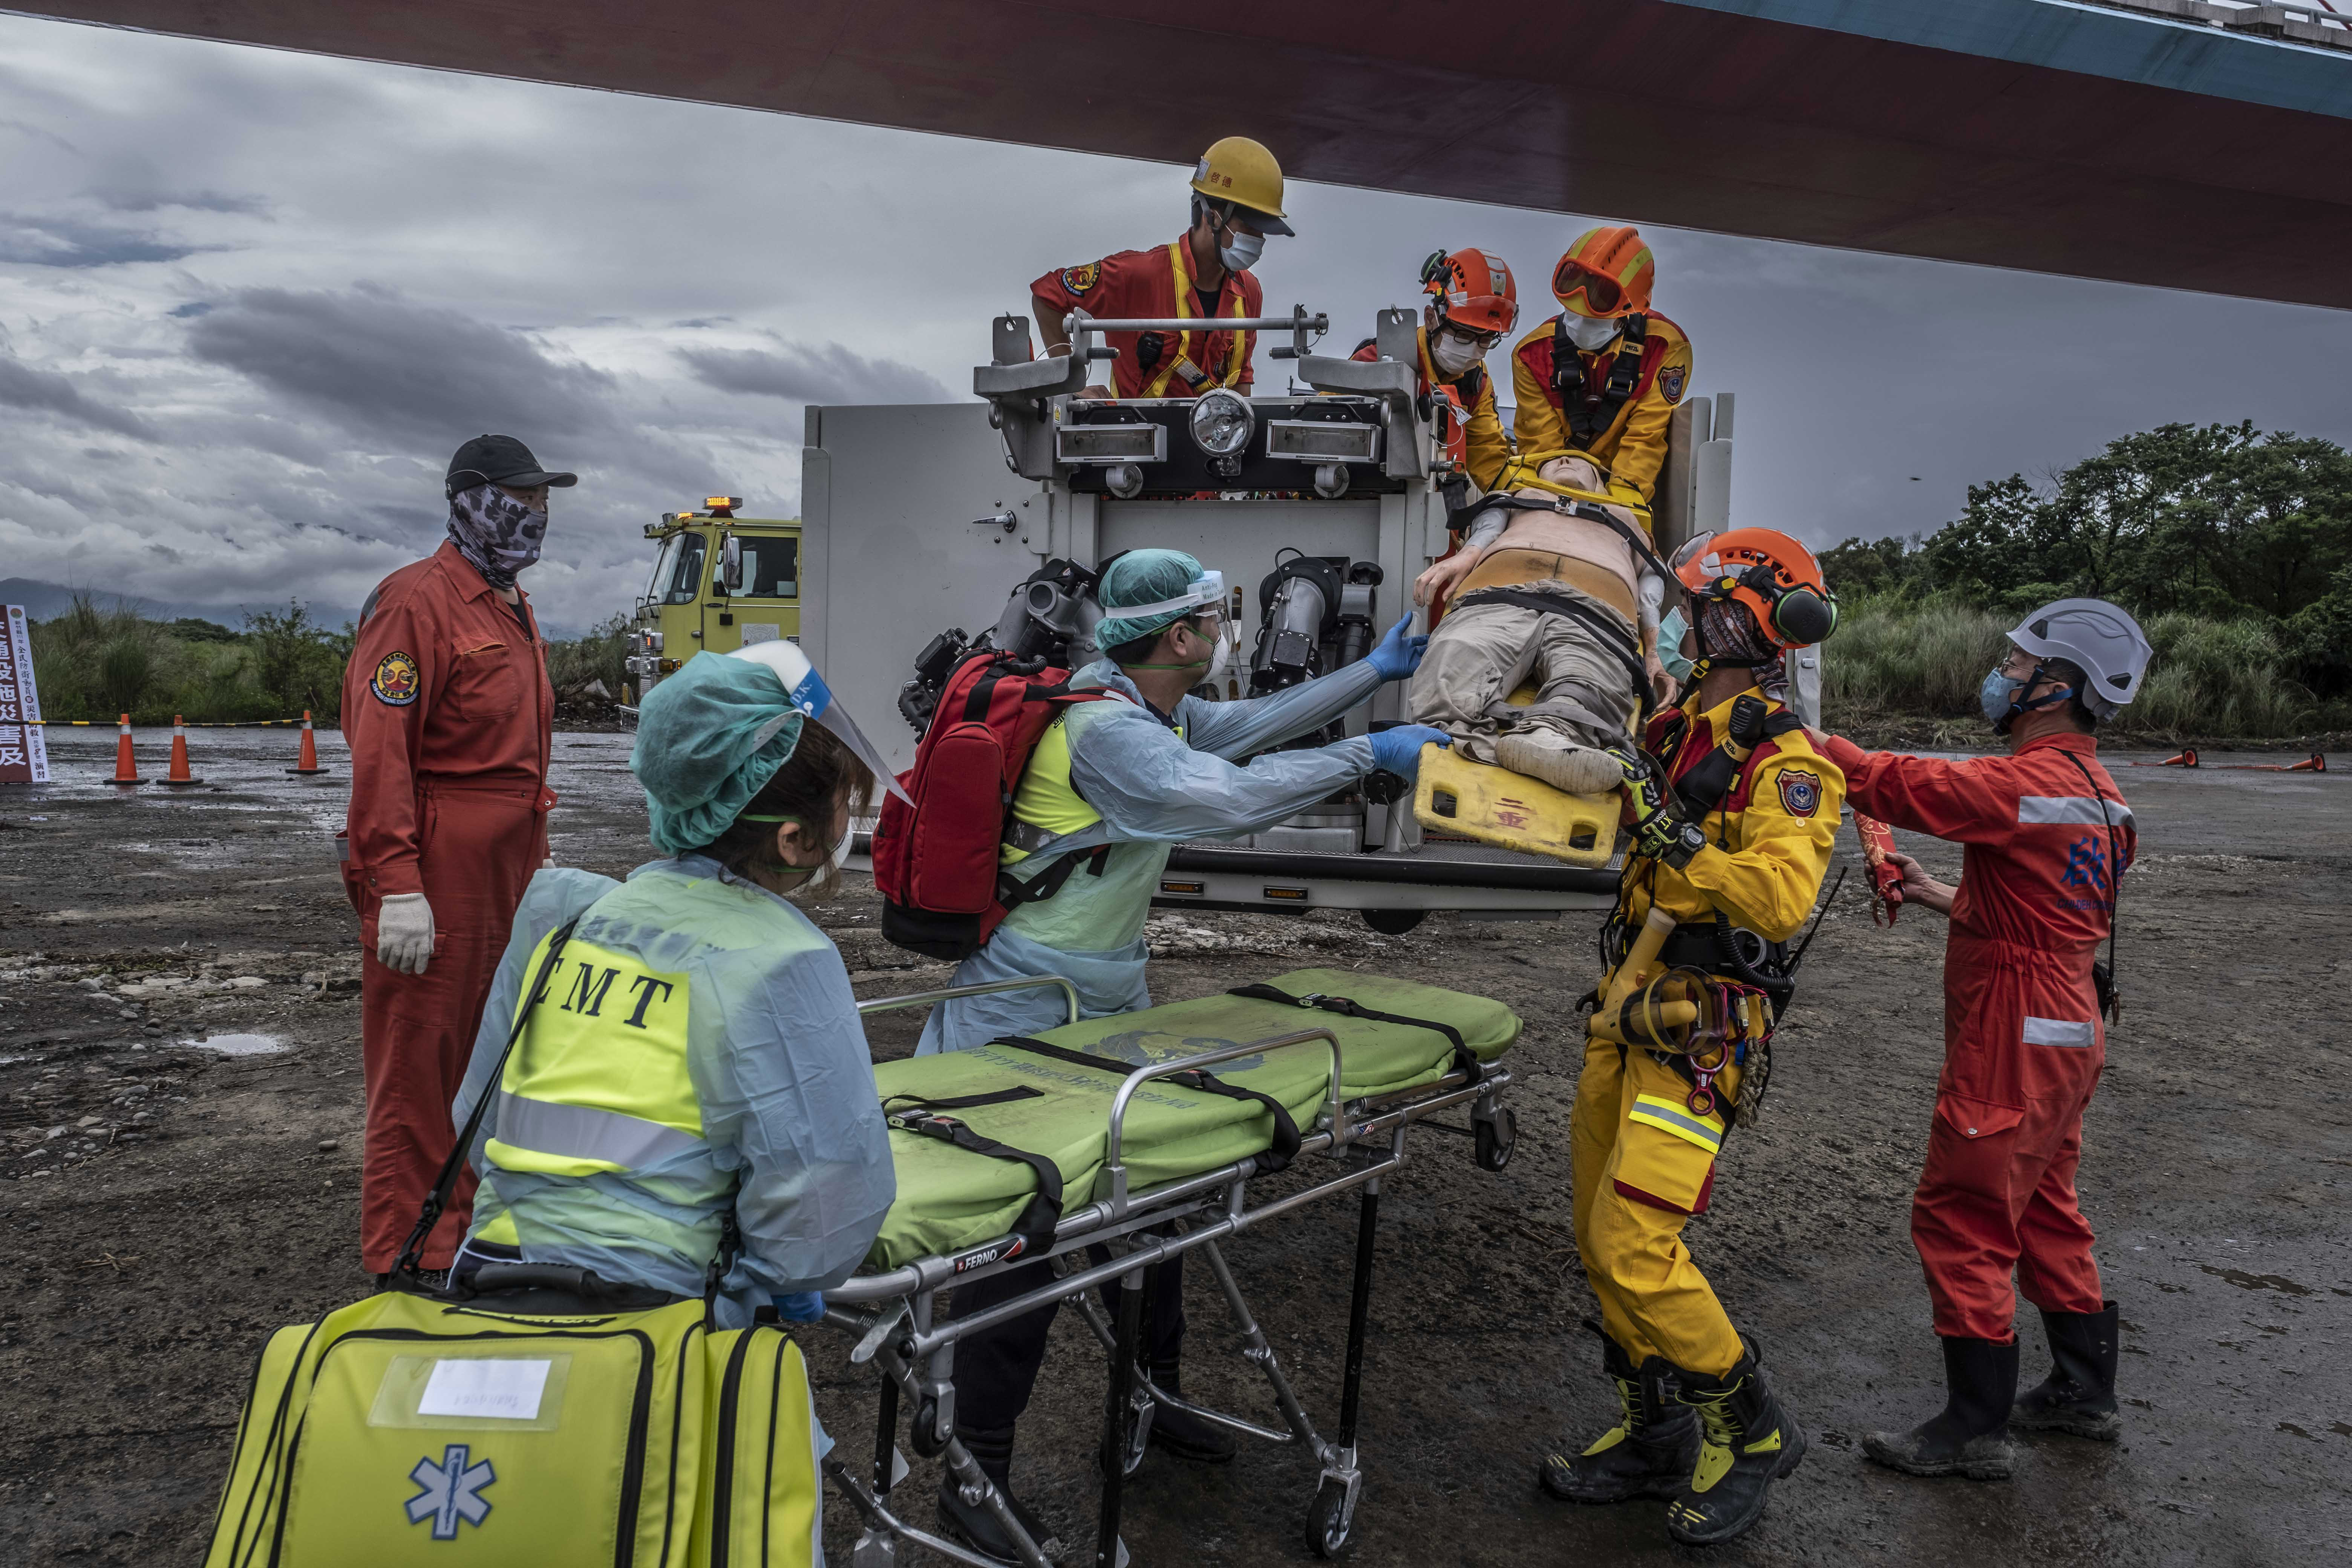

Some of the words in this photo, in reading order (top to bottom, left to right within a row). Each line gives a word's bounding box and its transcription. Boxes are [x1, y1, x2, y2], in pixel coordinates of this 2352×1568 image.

[1202, 582, 1217, 591] Anti-Fog
[1203, 592, 1213, 600] Made
[792, 682, 813, 703] D.K.
[1478, 1086, 1486, 1095] 25
[965, 1249, 997, 1271] FERNO
